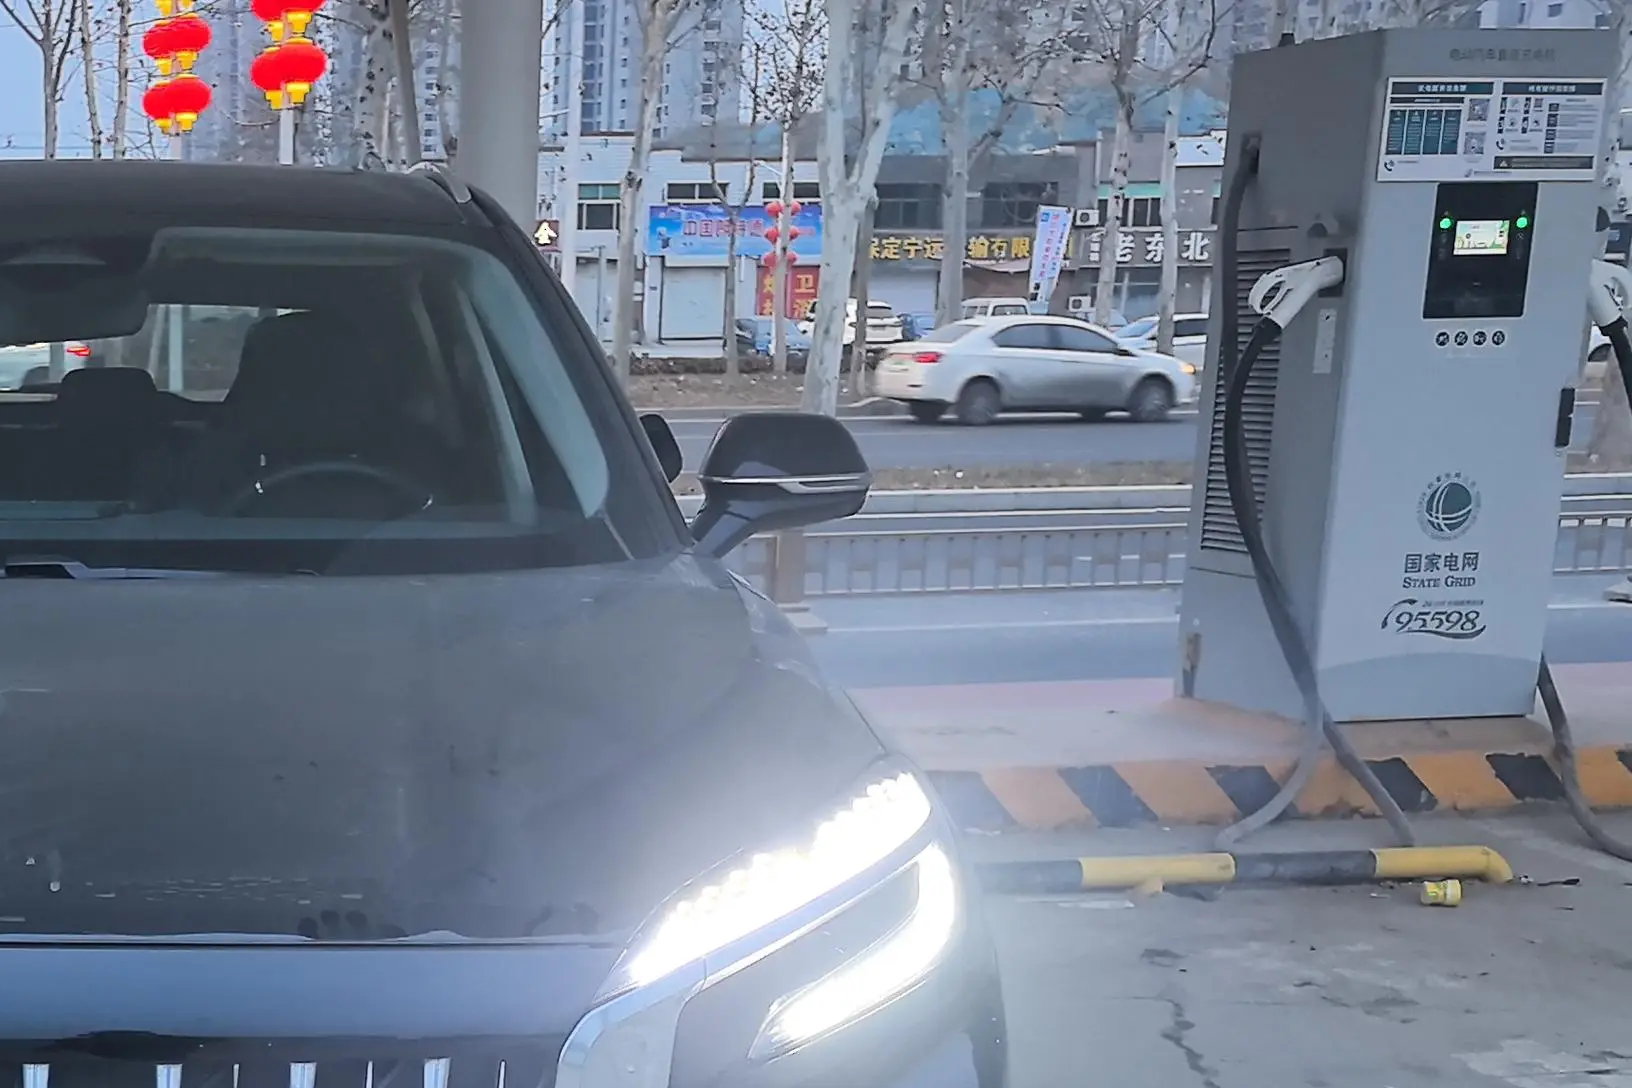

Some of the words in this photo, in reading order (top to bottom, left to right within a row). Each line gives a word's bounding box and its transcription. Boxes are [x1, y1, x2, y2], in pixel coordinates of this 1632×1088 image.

[1404, 551, 1480, 574] 国家电网
[1395, 610, 1481, 633] 95598
